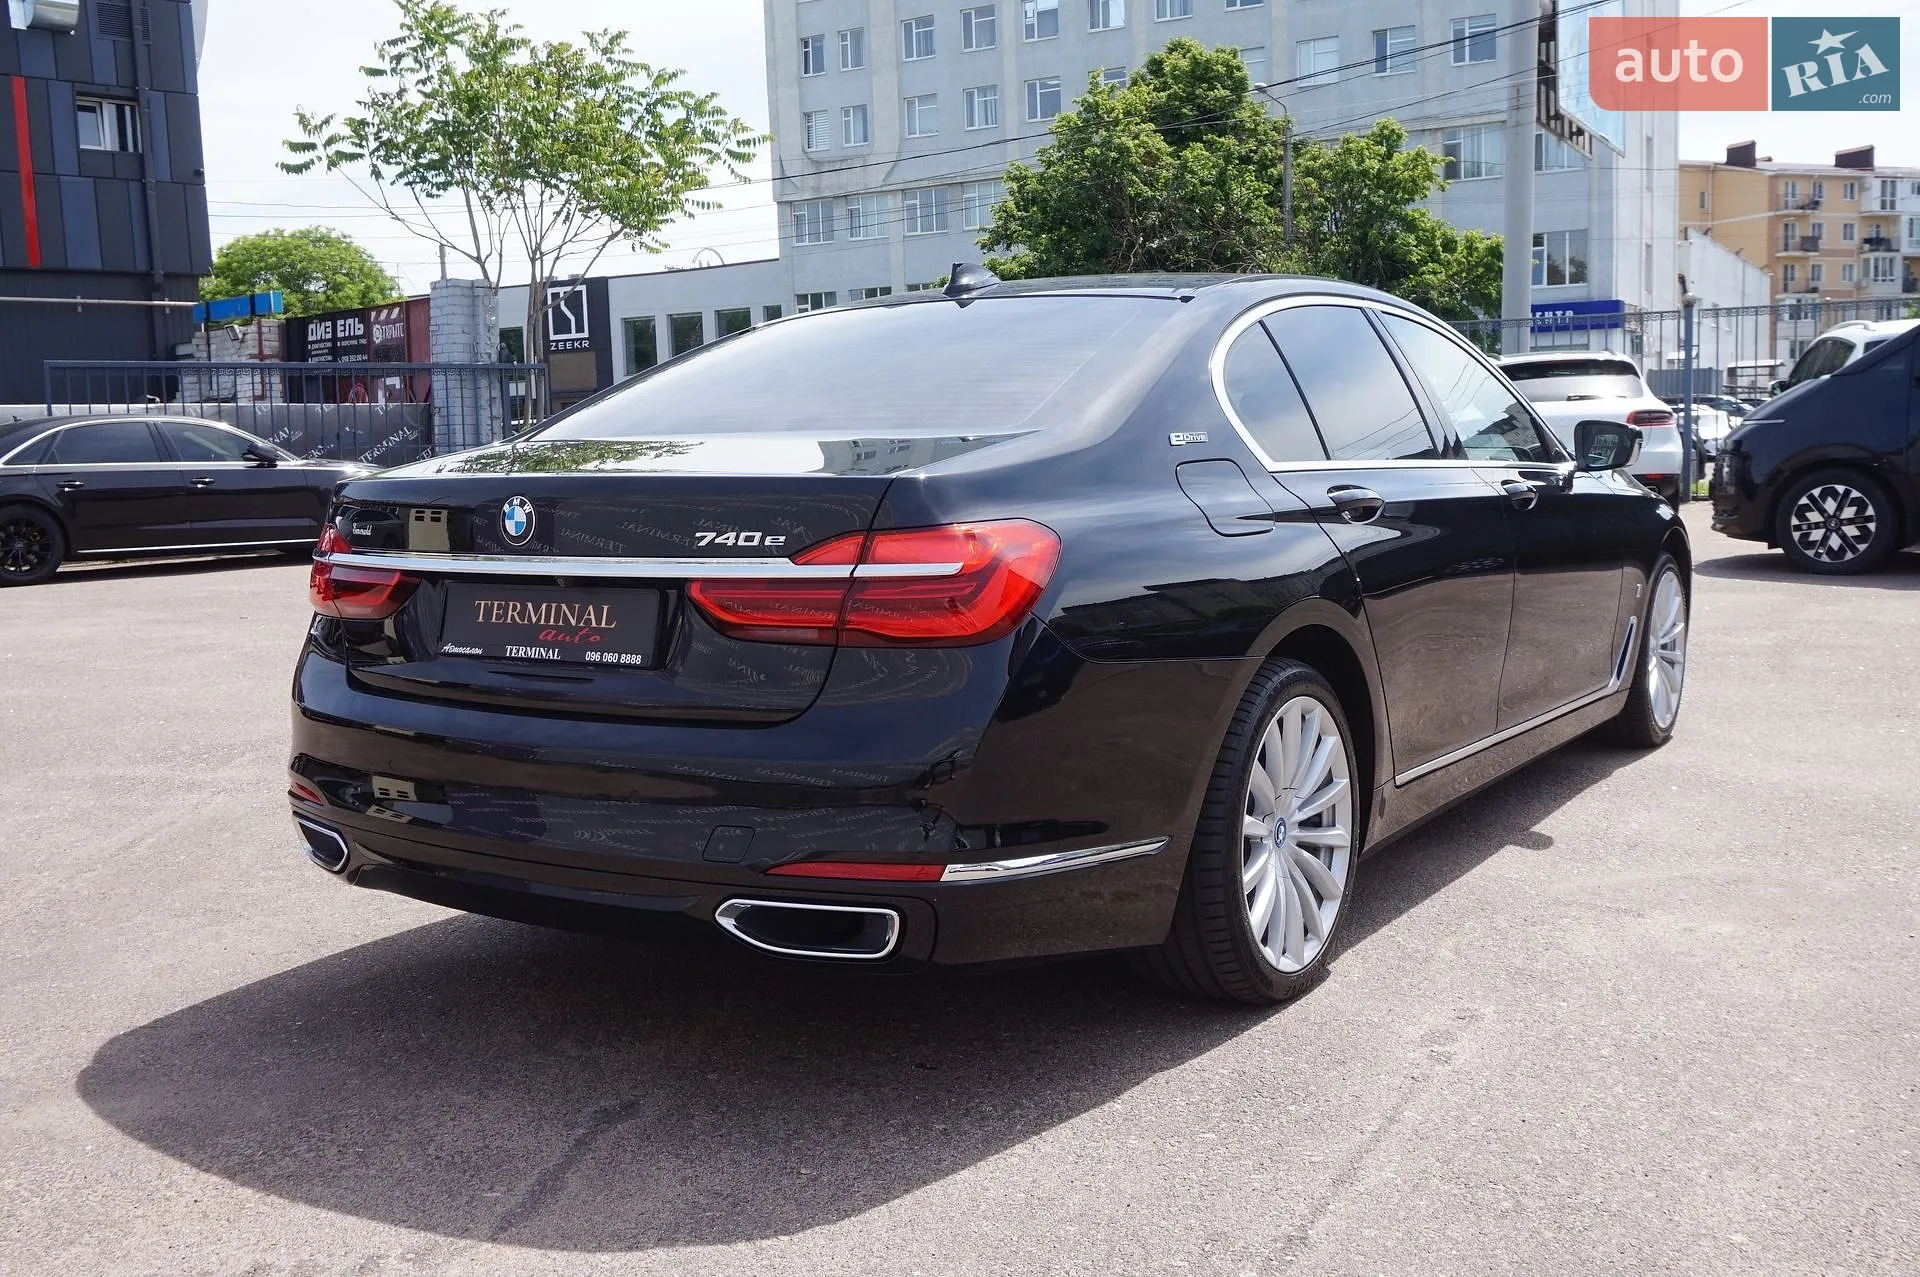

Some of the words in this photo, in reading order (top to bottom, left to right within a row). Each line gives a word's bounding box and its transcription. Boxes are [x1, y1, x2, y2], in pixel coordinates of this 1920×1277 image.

[550, 340, 590, 351] ZEEKR
[503, 497, 532, 513] BMW
[474, 600, 617, 629] TERMINAL
[538, 627, 608, 644] auto
[505, 645, 561, 660] TERMINAL
[585, 650, 601, 663] 096
[602, 652, 618, 664] 060
[620, 652, 642, 665] 8888
